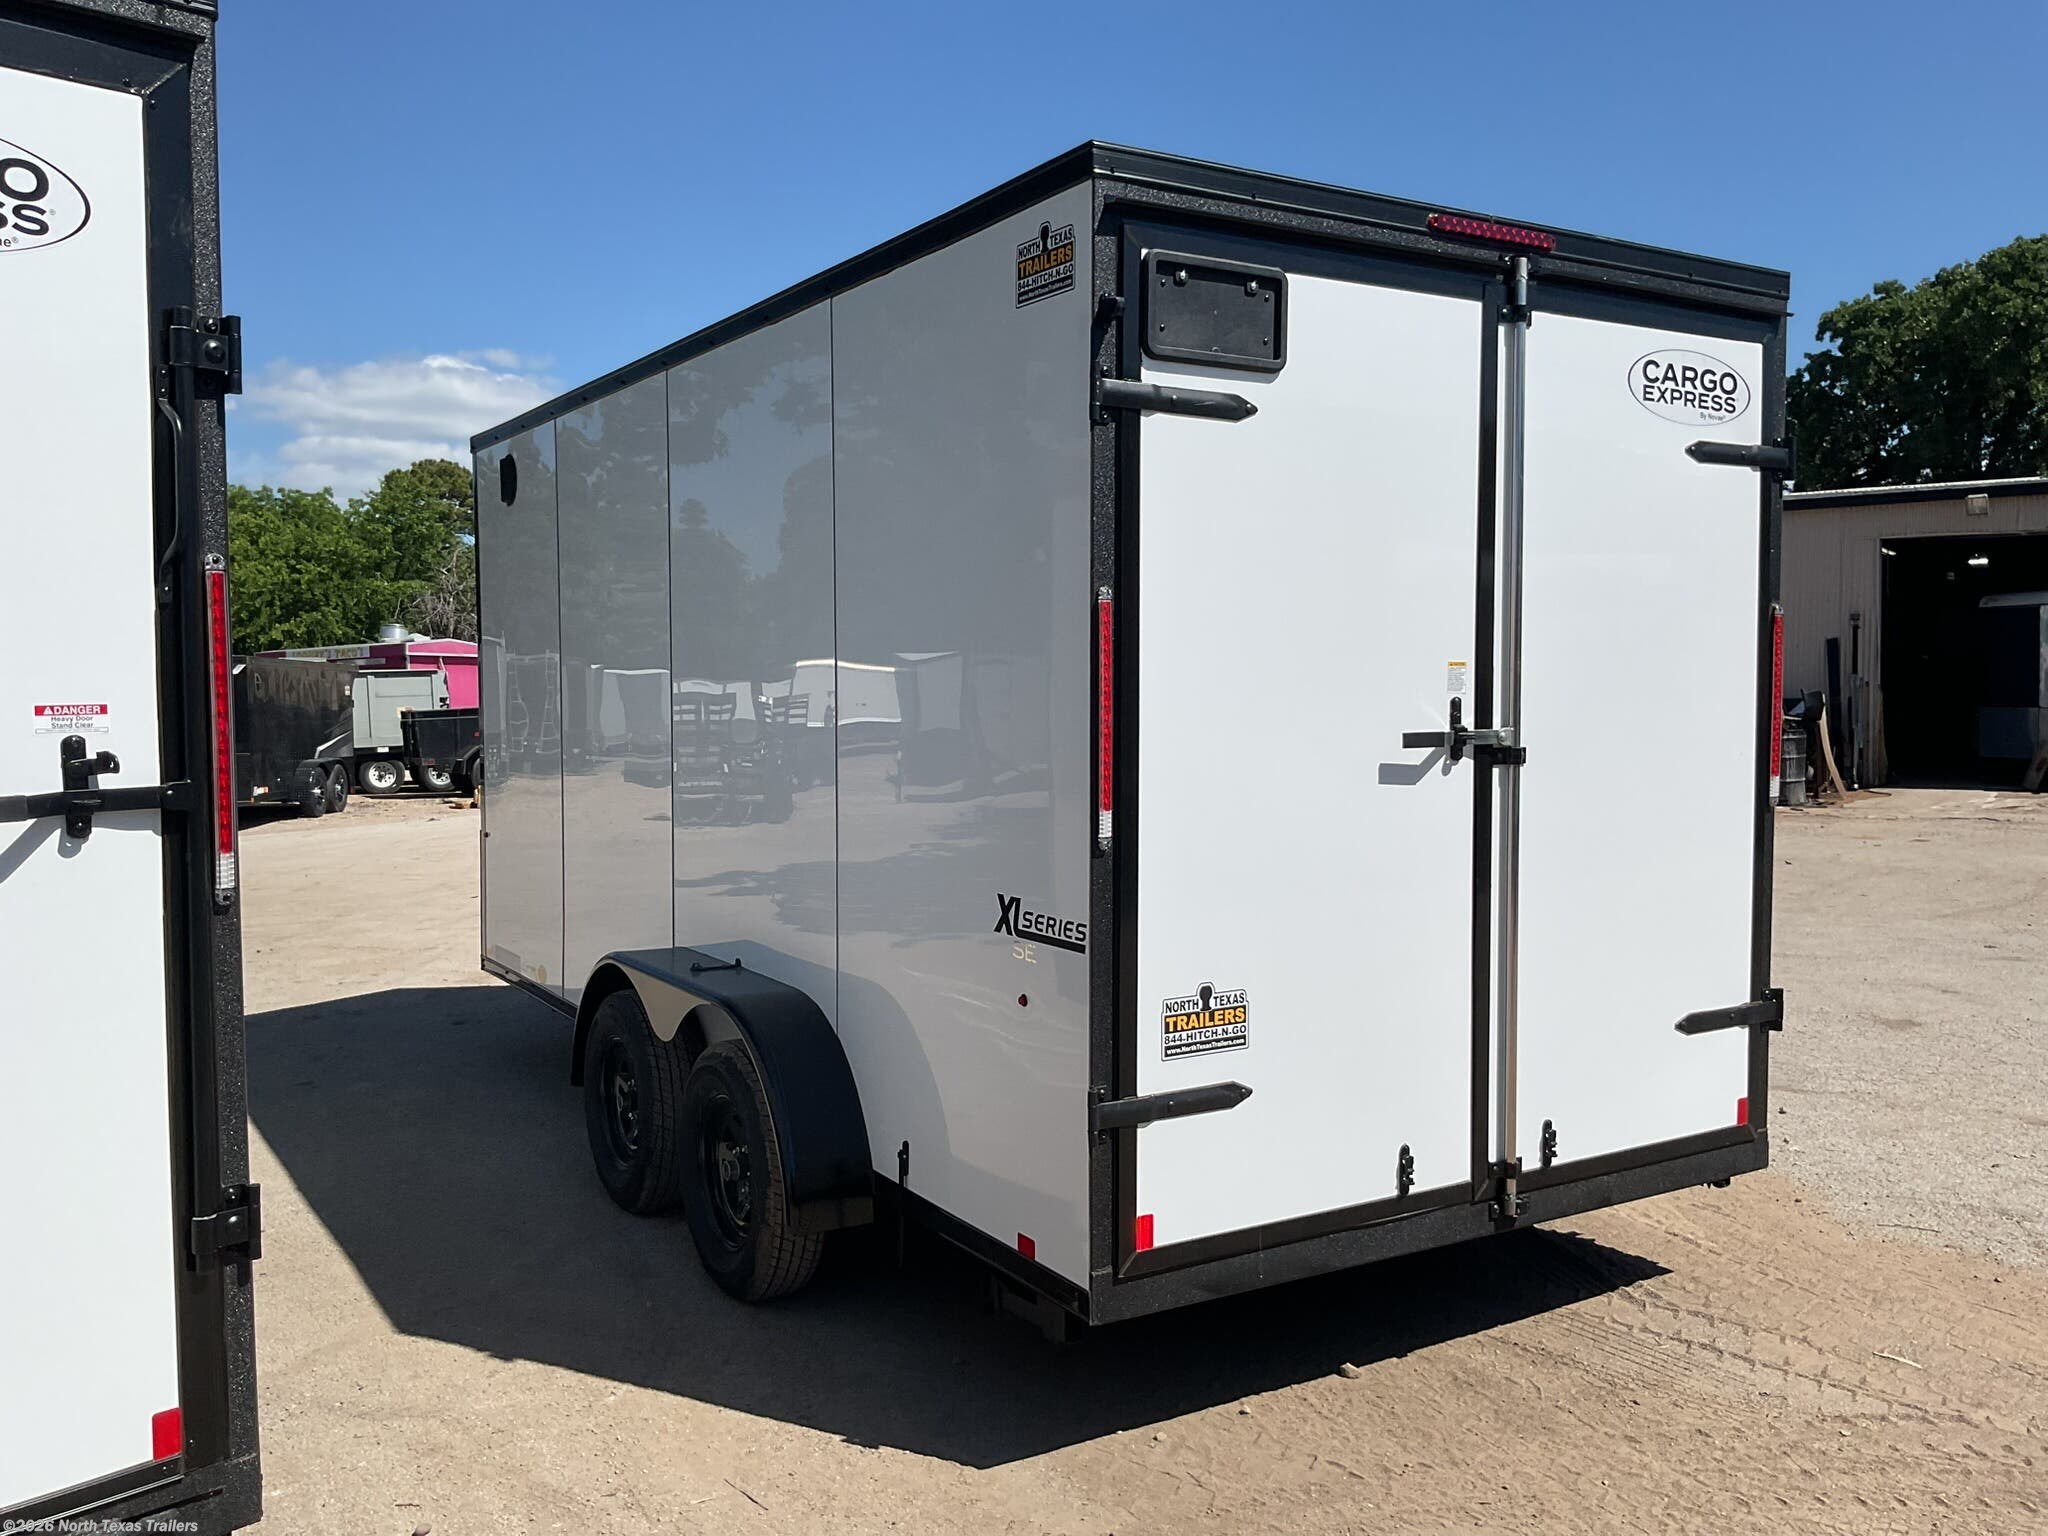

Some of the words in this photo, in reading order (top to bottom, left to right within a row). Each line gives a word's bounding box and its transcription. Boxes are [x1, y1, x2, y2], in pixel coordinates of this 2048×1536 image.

[1018, 240, 1041, 260] NORTH
[1050, 227, 1073, 247] TEXAS
[1019, 244, 1073, 279] TRAILERS
[1642, 359, 1738, 395] CARGO
[1642, 384, 1737, 414] EXPRESS
[53, 705, 101, 715] DANGER
[1022, 910, 1087, 942] SERIES
[1165, 998, 1199, 1014] NORTH
[1213, 992, 1245, 1007] TEXAS
[1166, 1007, 1245, 1032] TRAILERS
[1164, 1025, 1247, 1045] 844-HITCH-N-GO
